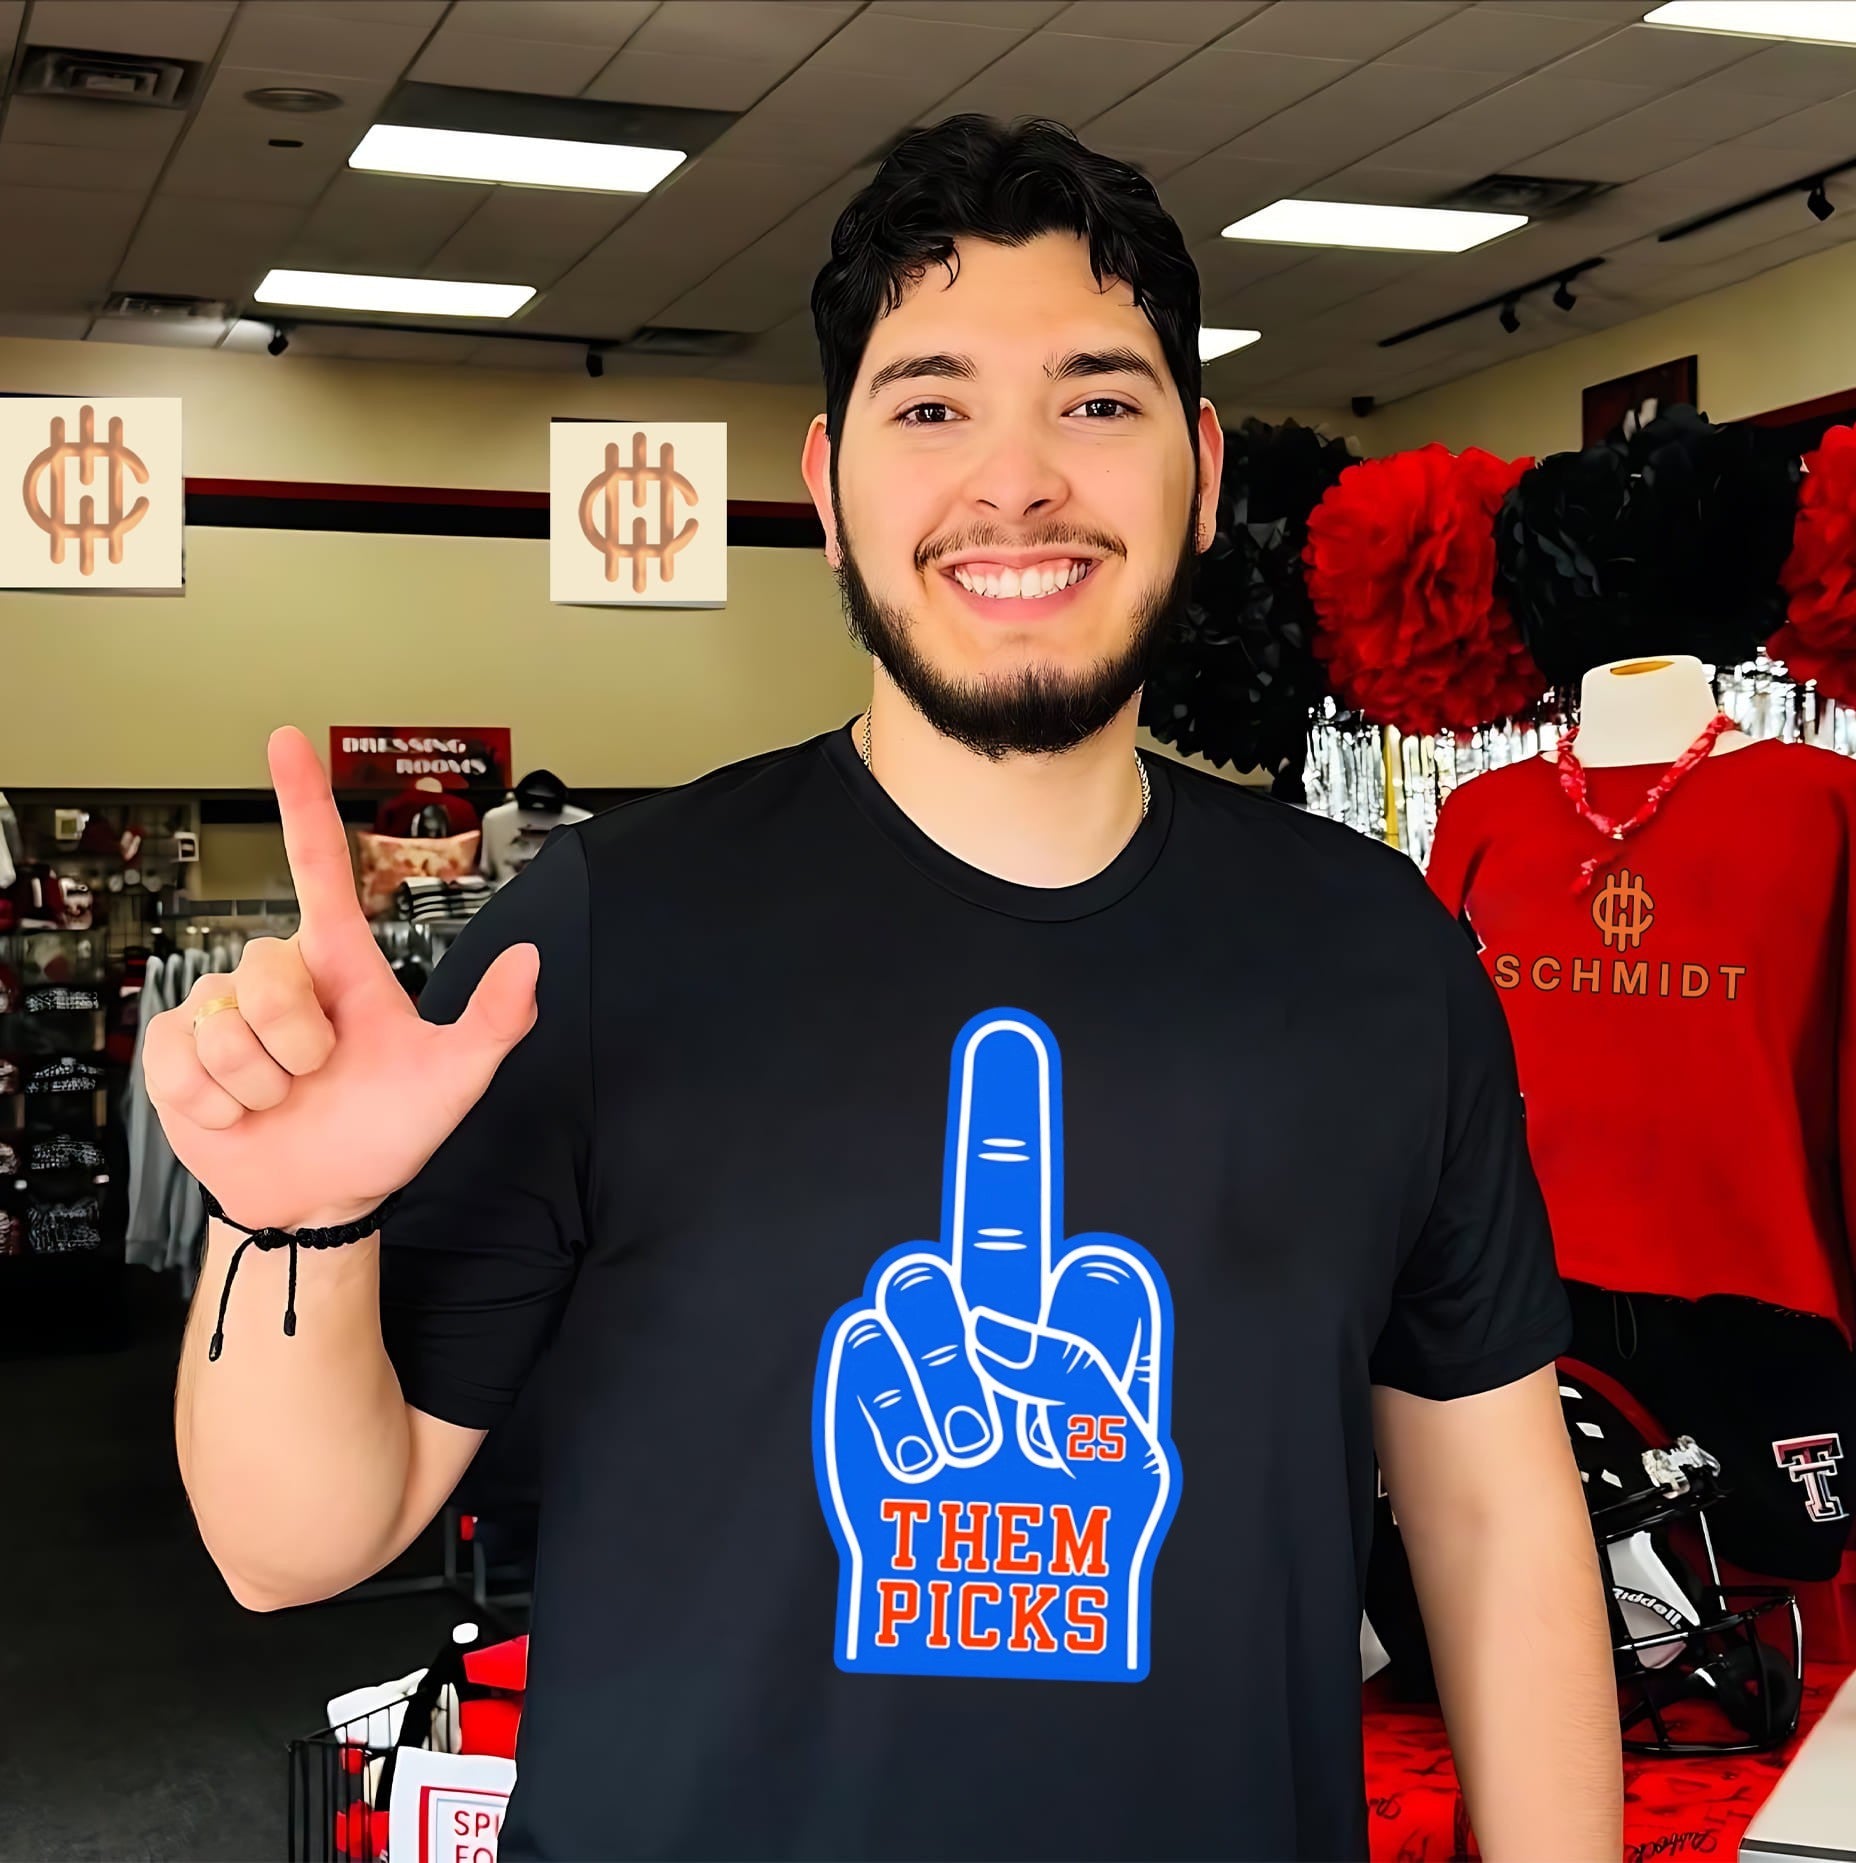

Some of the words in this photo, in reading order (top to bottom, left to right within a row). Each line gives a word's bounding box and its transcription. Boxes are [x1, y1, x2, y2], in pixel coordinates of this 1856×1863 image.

[342, 737, 467, 754] DRESSING
[396, 758, 487, 775] ROOMS
[1494, 954, 1747, 1000] SCHMIDT
[1068, 1414, 1126, 1461] 25
[881, 1498, 1110, 1576] THEM
[875, 1579, 1108, 1653] PICKS
